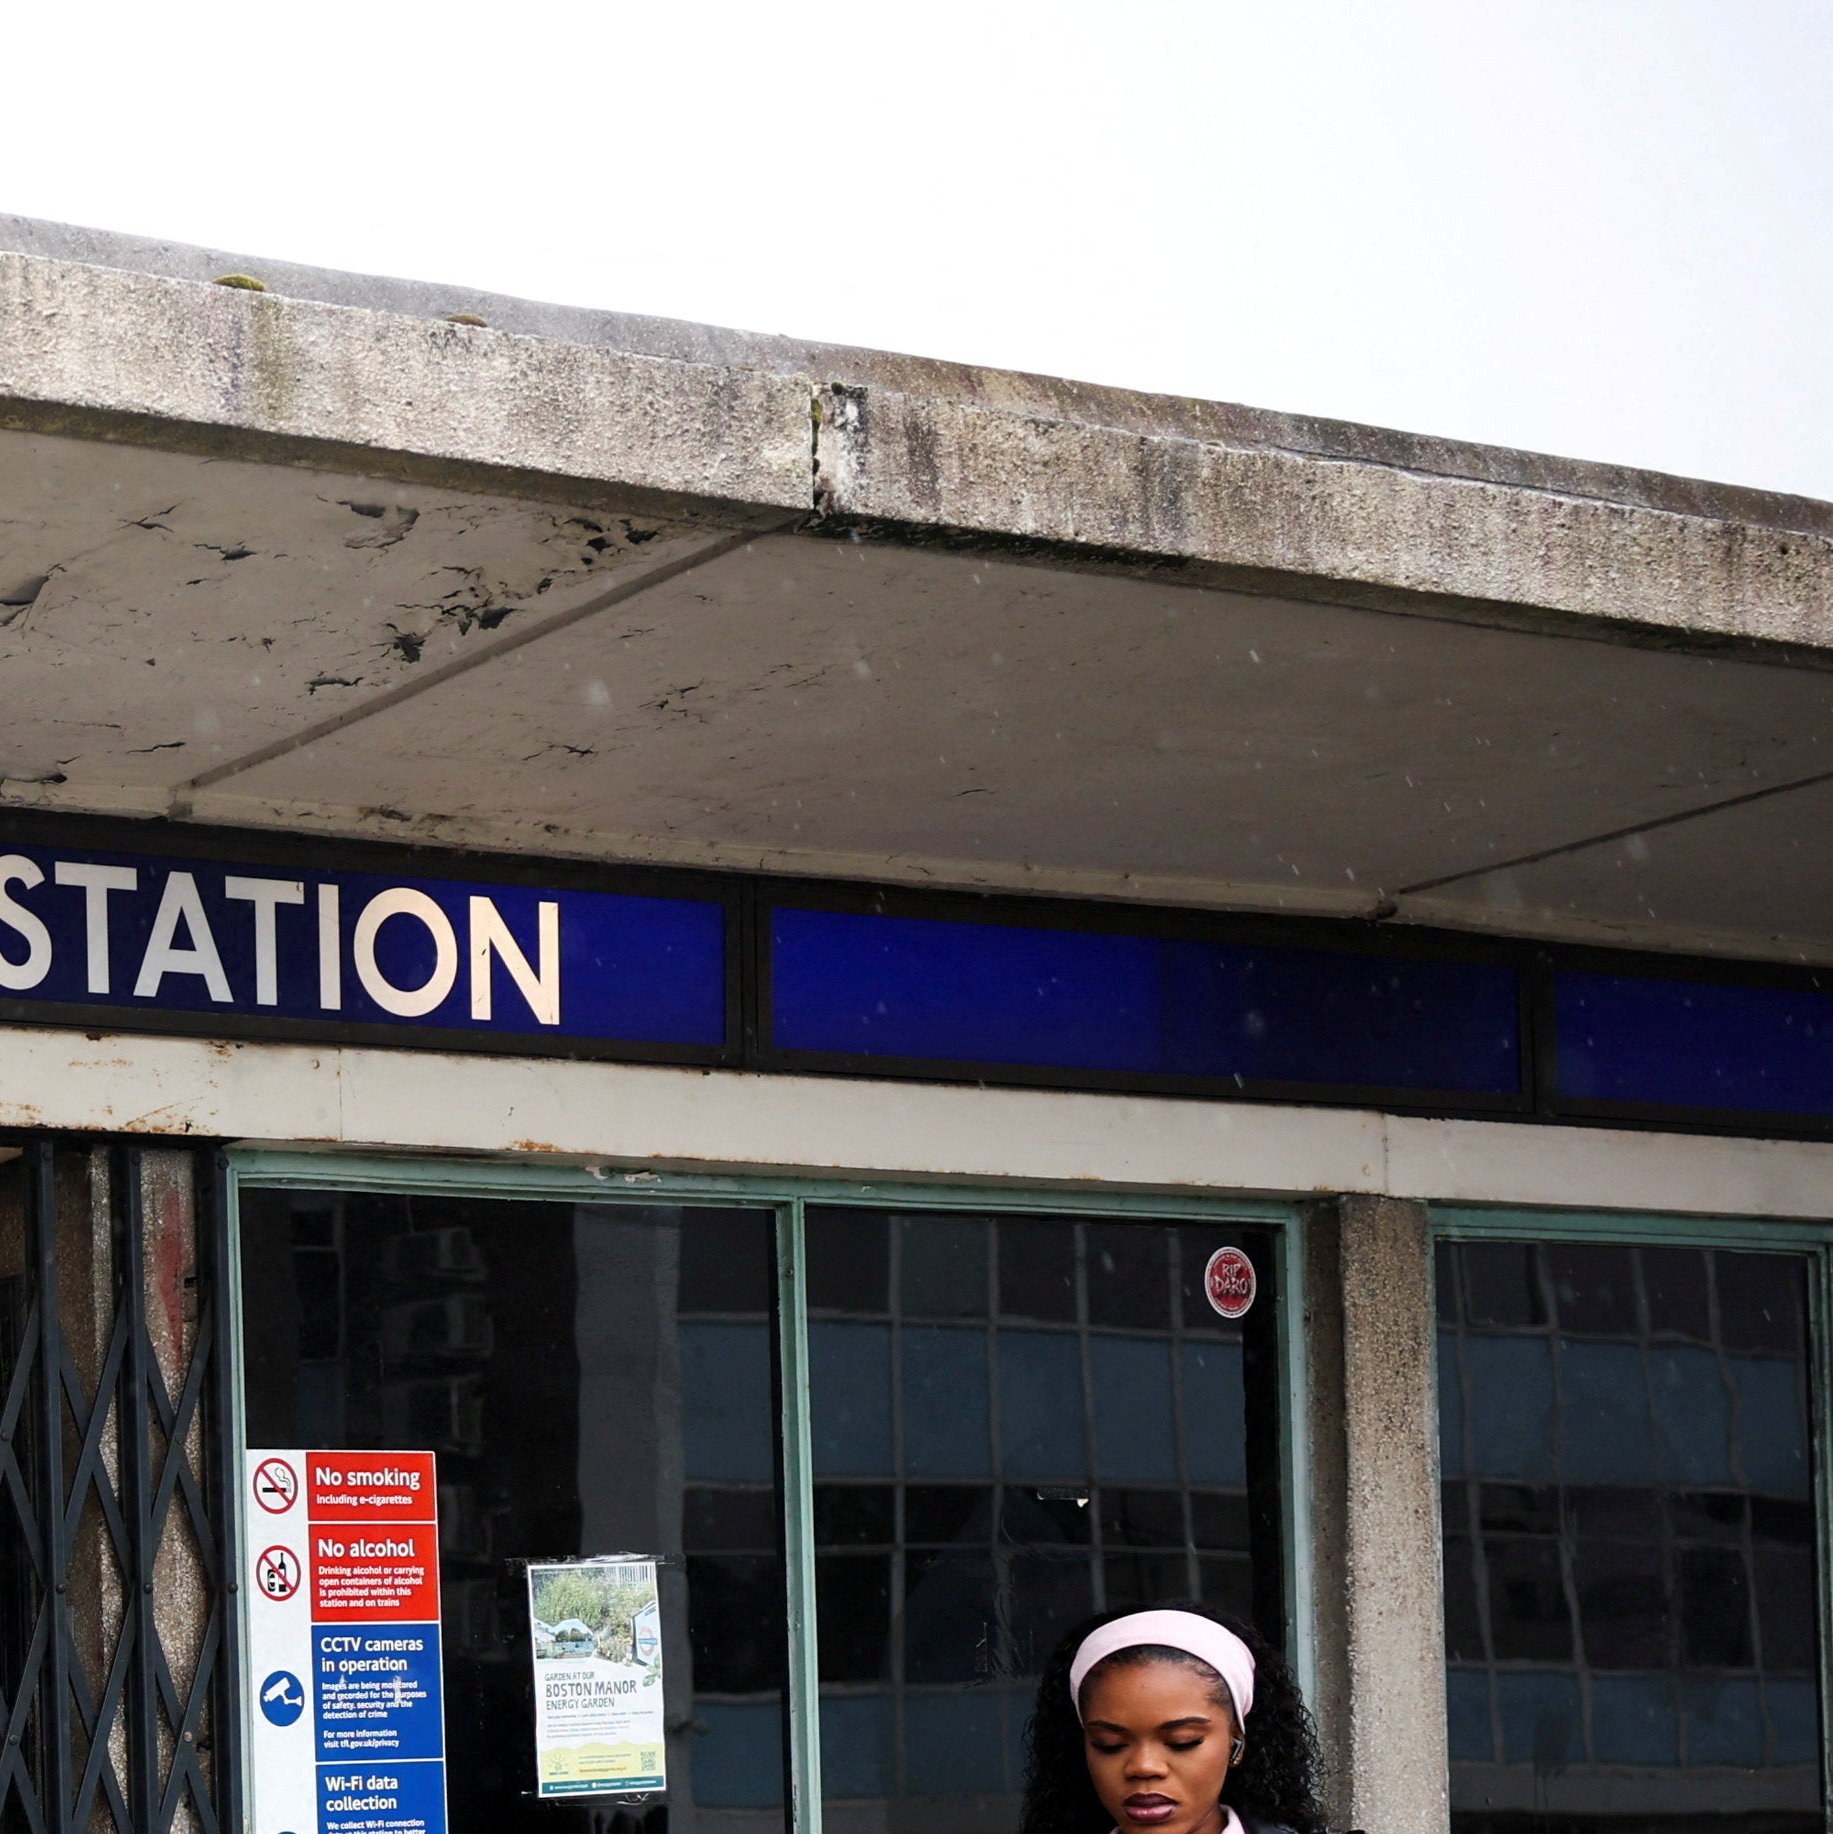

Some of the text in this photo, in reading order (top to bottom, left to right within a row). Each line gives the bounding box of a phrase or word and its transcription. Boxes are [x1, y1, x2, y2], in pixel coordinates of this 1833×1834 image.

[1222, 1263, 1241, 1278] RIP
[316, 1467, 420, 1490] No smoking
[316, 1494, 413, 1506] including e-cigarettes
[318, 1539, 415, 1557] No alcohol
[318, 1566, 351, 1576] Drinking
[353, 1566, 382, 1575] alcohol
[394, 1567, 424, 1576] carrying
[319, 1576, 423, 1586] open containers of alcohol
[319, 1587, 411, 1598] is prohibited within this
[319, 1599, 347, 1607] station
[349, 1599, 364, 1607] and
[378, 1598, 400, 1606] trains
[321, 1636, 424, 1652] CCTV cameras
[321, 1657, 408, 1675] in operation
[544, 1672, 595, 1682] GARDEN AT OUR
[545, 1680, 637, 1698] BOSTON MANOR
[546, 1697, 615, 1711] ENERGY GARDEN
[323, 1730, 335, 1739] For
[356, 1729, 397, 1738] information
[324, 1740, 339, 1748] visit
[325, 1775, 398, 1791] Wi-Fi data
[326, 1795, 398, 1811] collection
